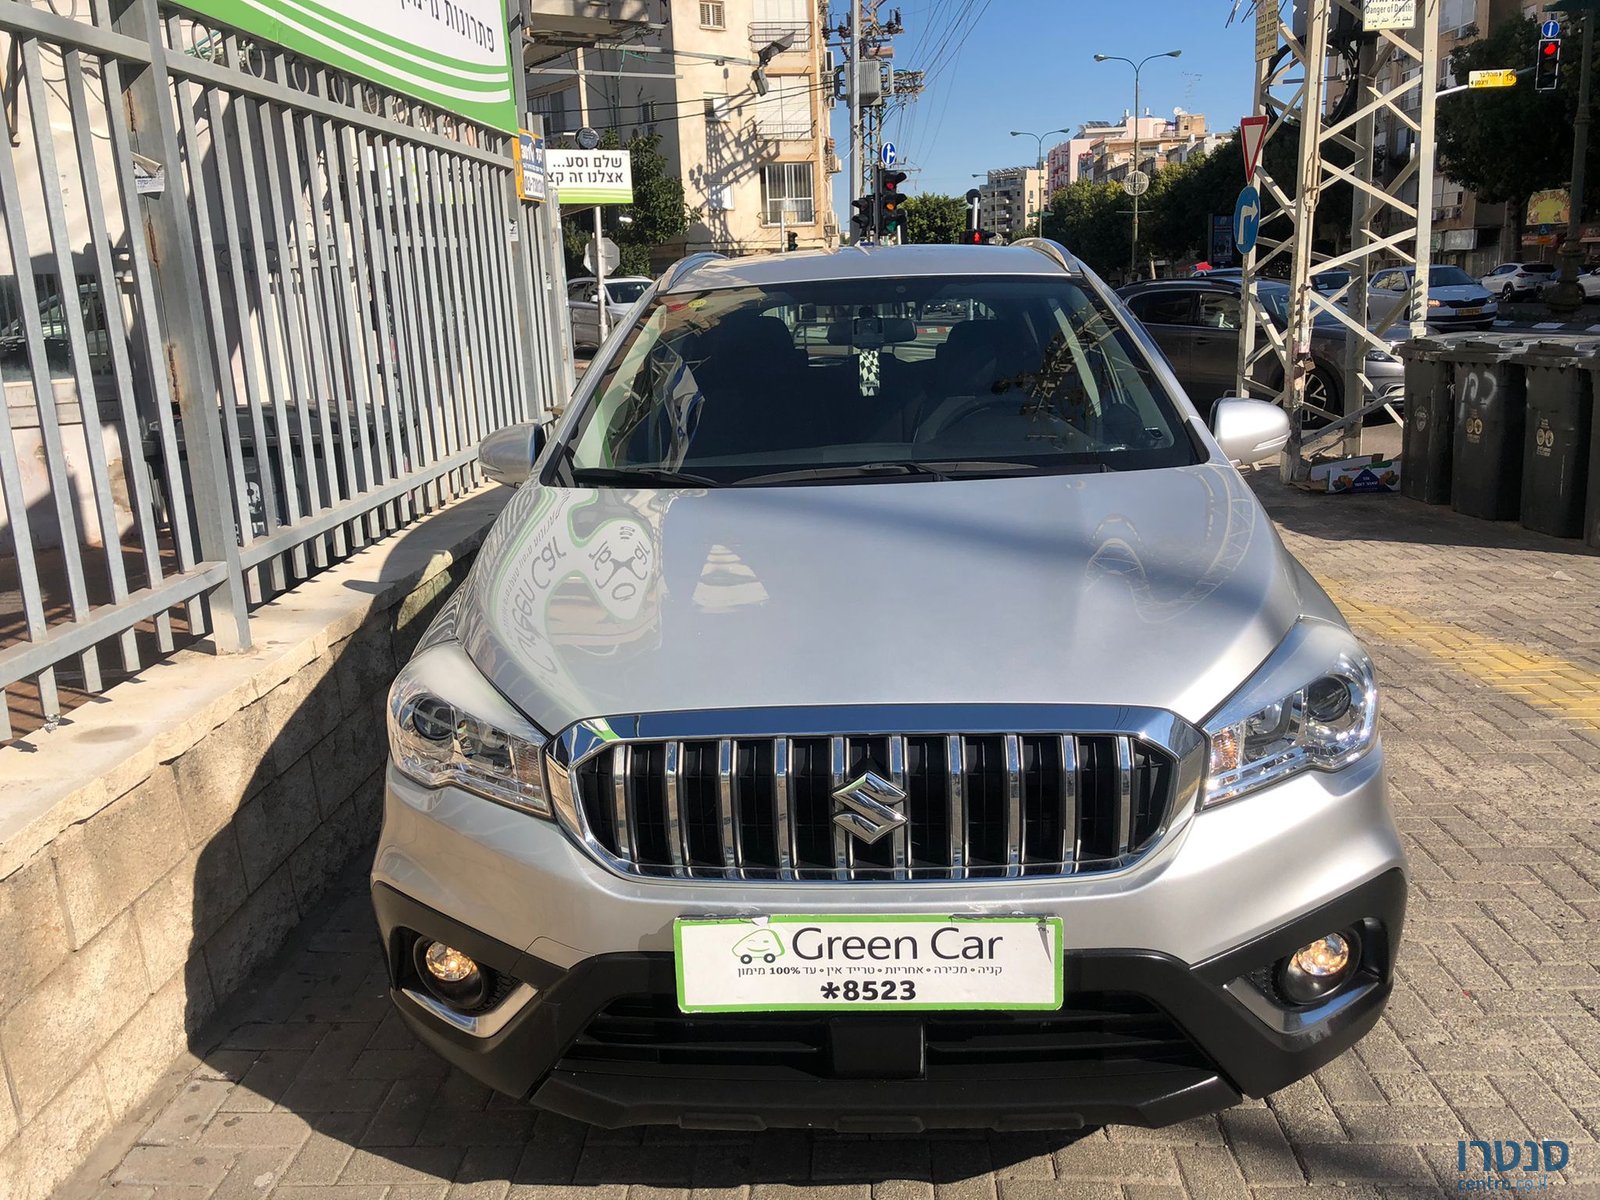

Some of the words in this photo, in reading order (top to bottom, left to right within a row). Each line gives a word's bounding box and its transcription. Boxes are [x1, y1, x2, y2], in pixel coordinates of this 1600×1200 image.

[1366, 4, 1386, 16] Danger
[1387, 4, 1393, 13] of
[444, 0, 495, 53] פתרונות
[594, 154, 622, 169] שלם
[569, 172, 583, 183] זה
[587, 170, 623, 183] אצלנו
[792, 926, 918, 961] Green
[930, 926, 1003, 961] Car
[738, 966, 766, 978] מימון
[769, 966, 801, 976] 100%
[803, 966, 817, 975] עד
[827, 966, 843, 978] אין
[846, 966, 875, 975] טרייד
[884, 966, 924, 975] אחריות
[934, 966, 968, 975] מכירה
[978, 966, 1003, 977] קניה
